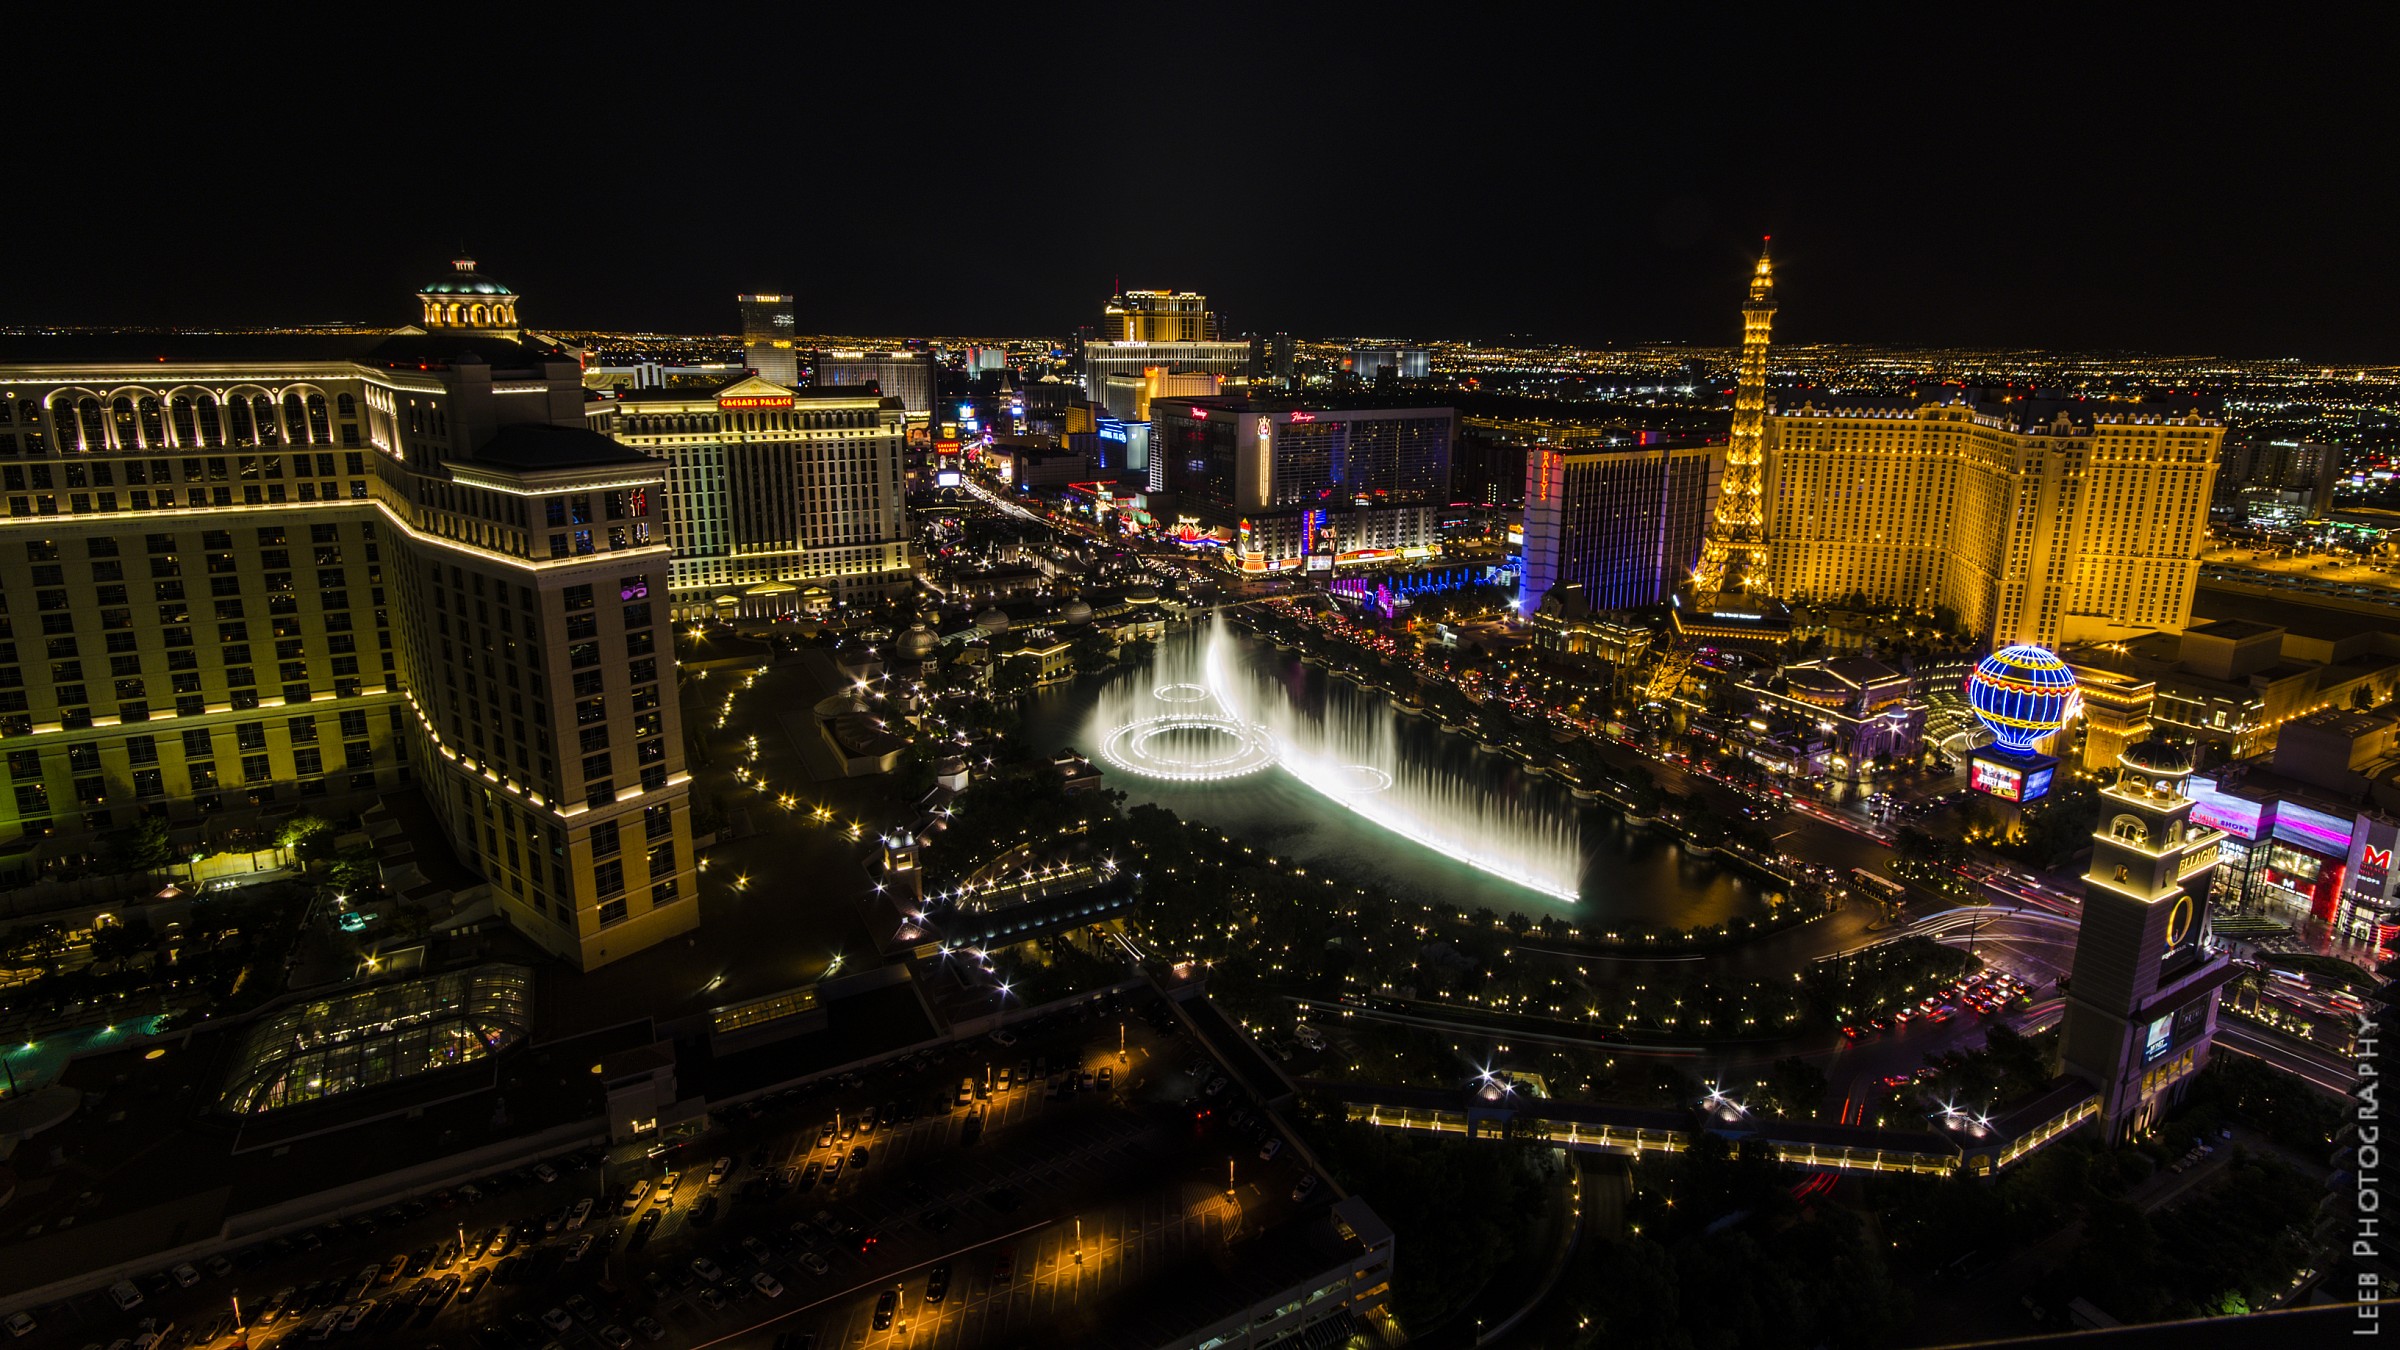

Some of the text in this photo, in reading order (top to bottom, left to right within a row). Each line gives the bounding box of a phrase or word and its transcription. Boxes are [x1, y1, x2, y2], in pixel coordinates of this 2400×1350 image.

[721, 398, 792, 407] CAESARS PALACE
[2221, 820, 2249, 833] SHOPS
[2180, 845, 2218, 872] ELLAGIO
[2357, 874, 2380, 885] SHOPS
[2347, 887, 2391, 906] SEPHORA
